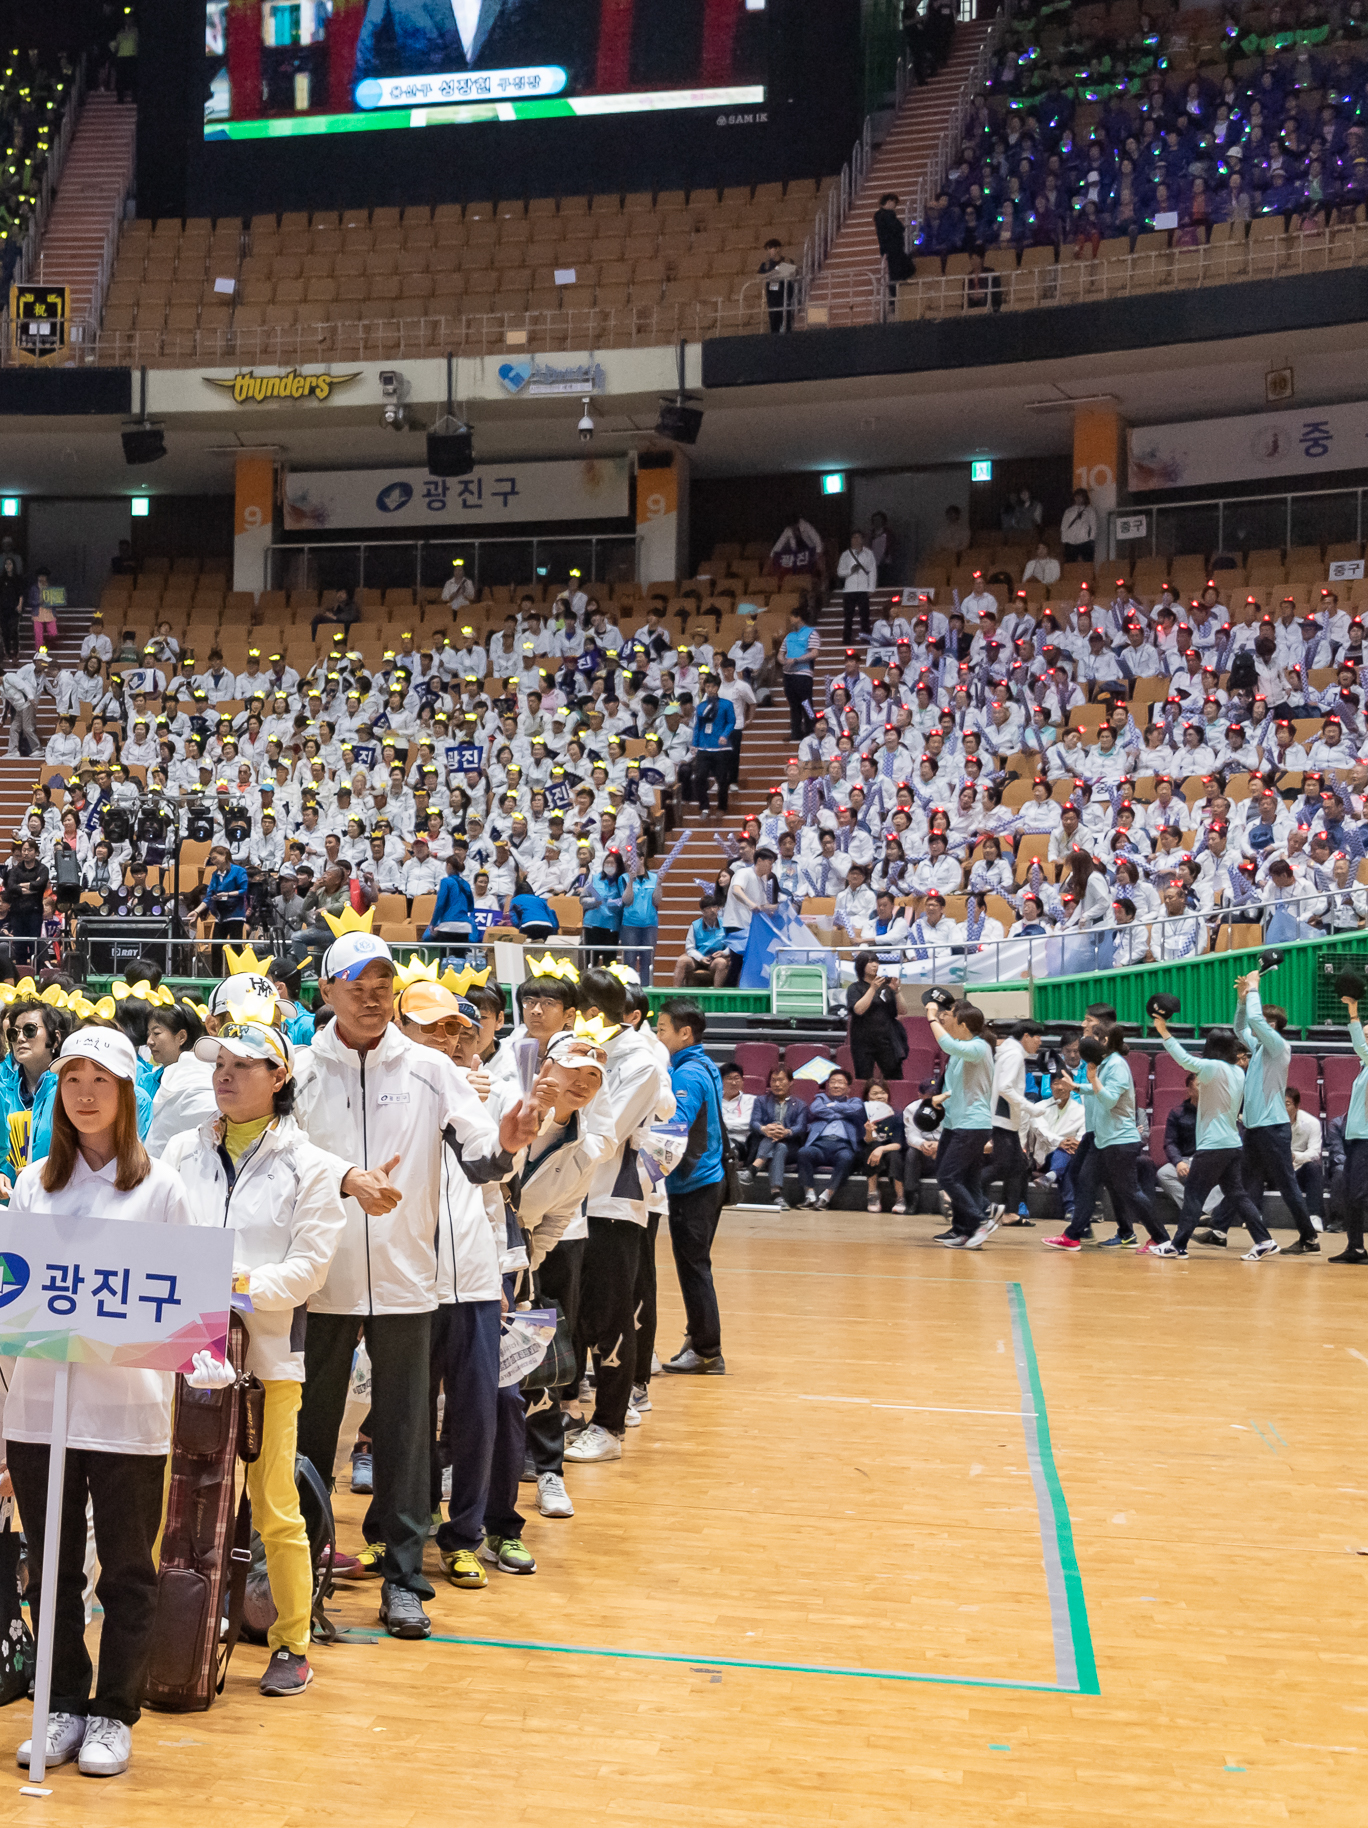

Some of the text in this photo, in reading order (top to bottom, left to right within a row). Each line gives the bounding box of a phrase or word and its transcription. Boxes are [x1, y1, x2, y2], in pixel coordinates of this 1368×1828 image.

[1075, 464, 1113, 490] 10
[421, 477, 521, 512] 광진구
[645, 493, 667, 520] 9
[243, 505, 262, 532] 9
[1120, 519, 1143, 534] 중구
[1333, 562, 1361, 577] 중구
[447, 750, 479, 771] 광진
[41, 1263, 182, 1324] 광진구
